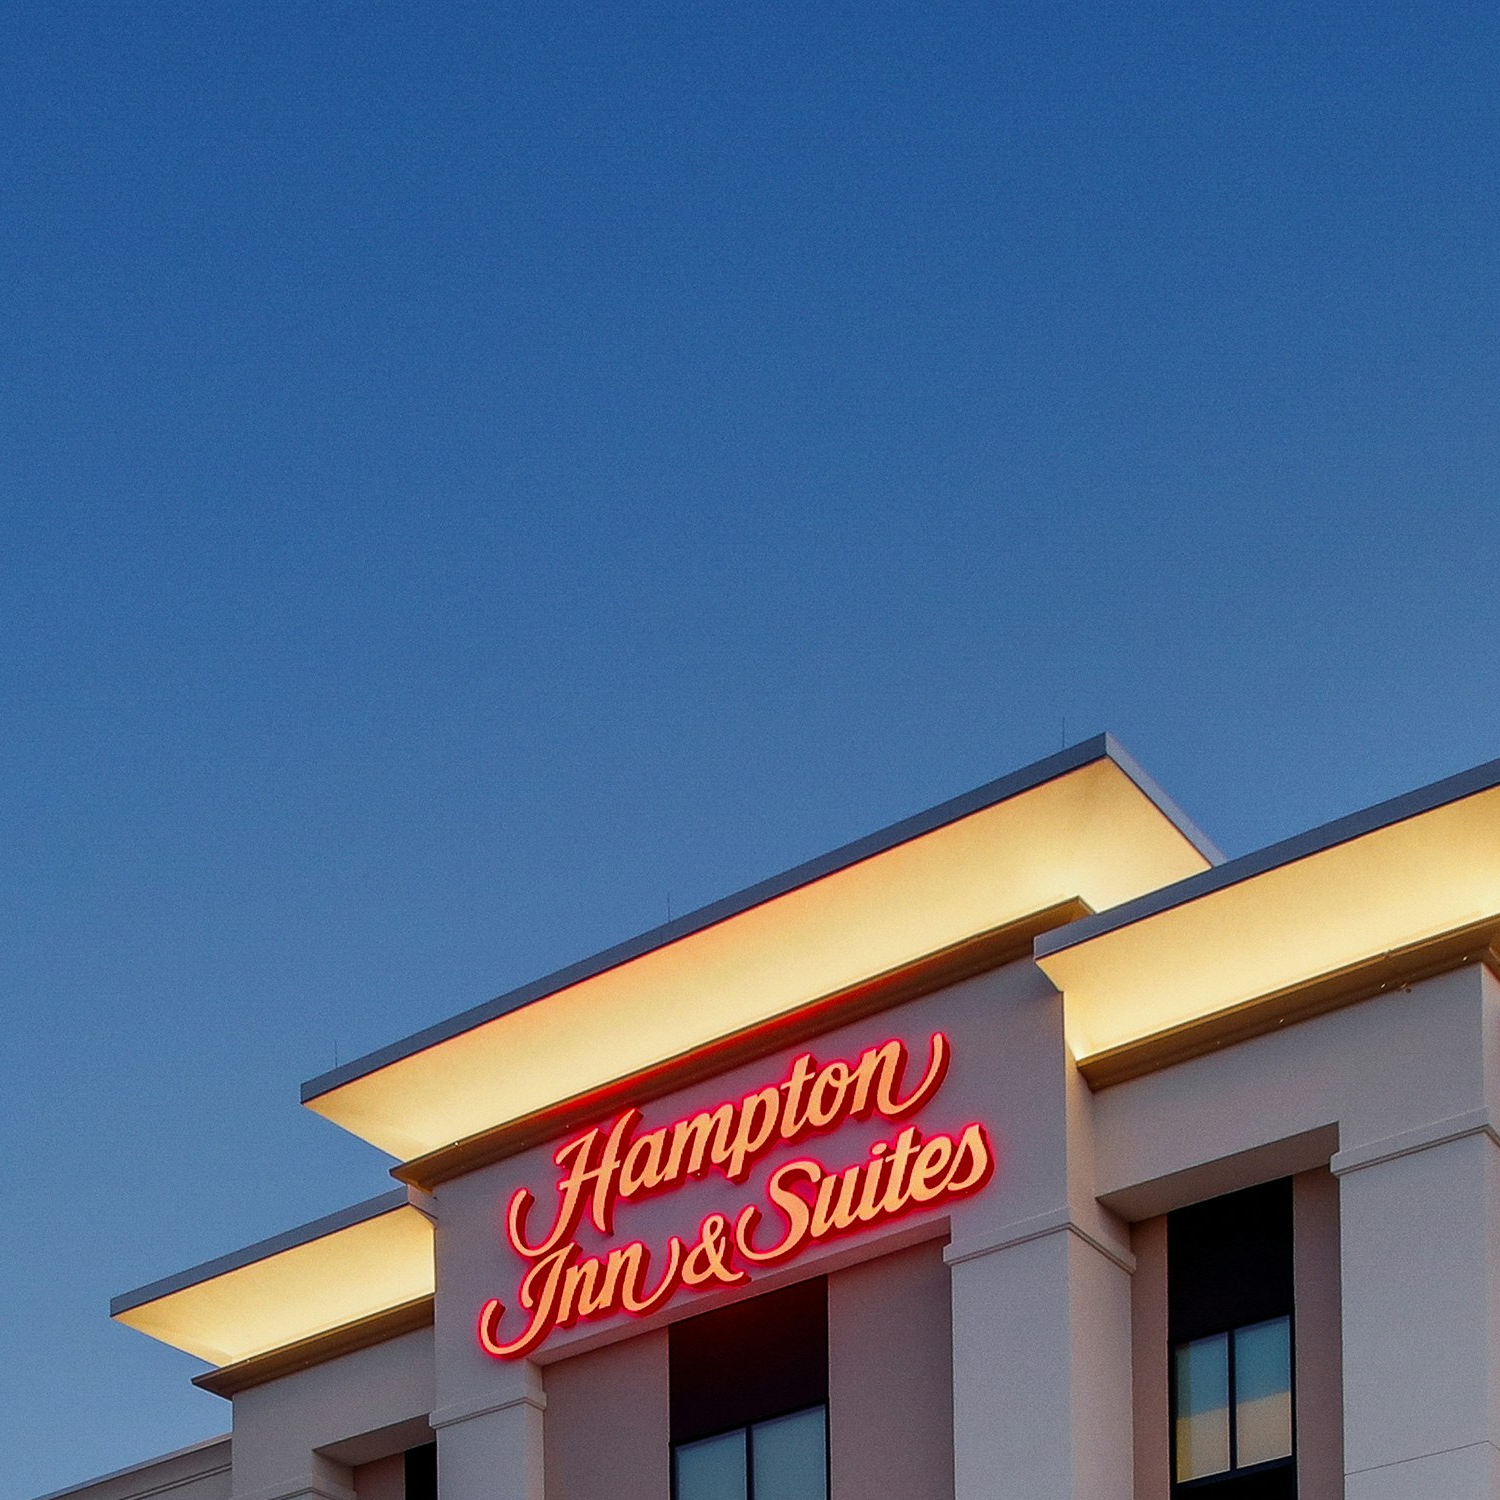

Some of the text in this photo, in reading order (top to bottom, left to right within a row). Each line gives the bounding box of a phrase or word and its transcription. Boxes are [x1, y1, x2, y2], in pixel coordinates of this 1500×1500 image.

[479, 1122, 995, 1360] Inn & Suites
[506, 1031, 951, 1259] Hampton
